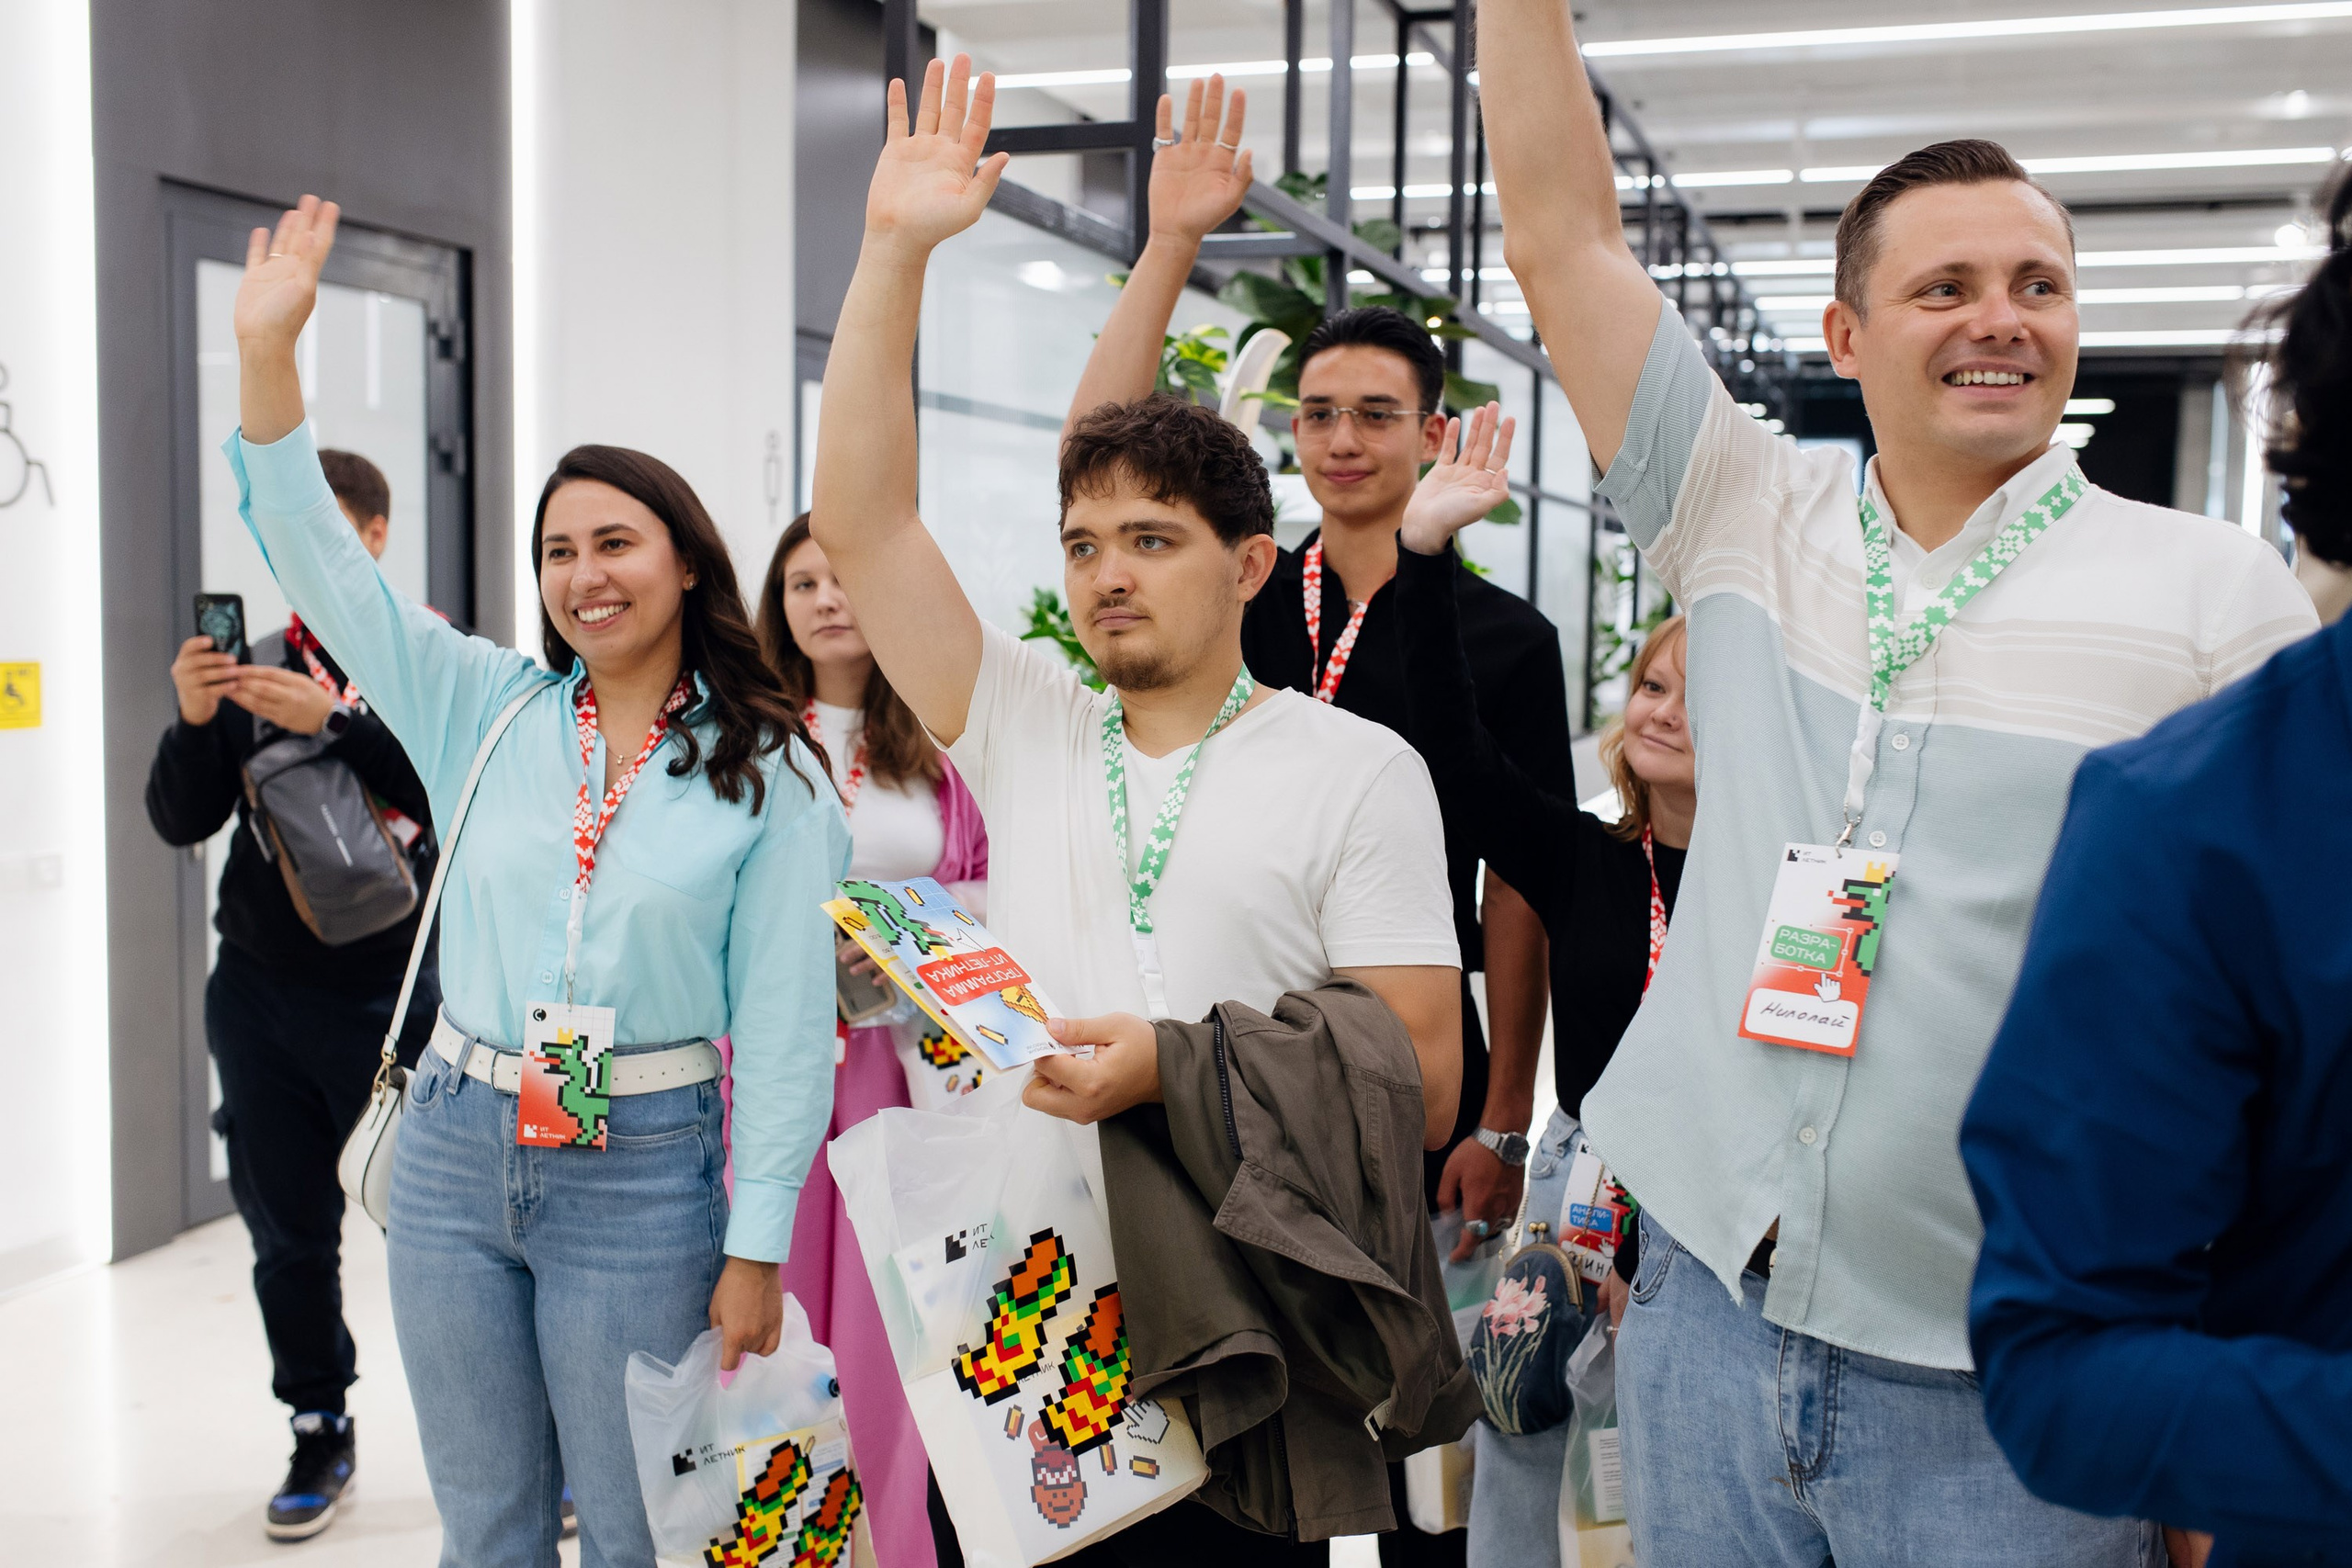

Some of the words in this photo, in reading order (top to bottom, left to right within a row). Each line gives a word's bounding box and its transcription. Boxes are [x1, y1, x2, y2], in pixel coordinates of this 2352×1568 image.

[1779, 929, 1838, 950] РАЗРА-
[1774, 942, 1826, 964] БОТКА
[925, 953, 1009, 983] ИТ-ЛЕТНИКА
[942, 966, 1023, 998] ПРОГРАММА
[973, 1223, 988, 1236] ИТ
[1572, 1214, 1599, 1227] ТИА
[699, 1443, 714, 1454] ИТ
[704, 1445, 746, 1465] ЛЕТНИК
